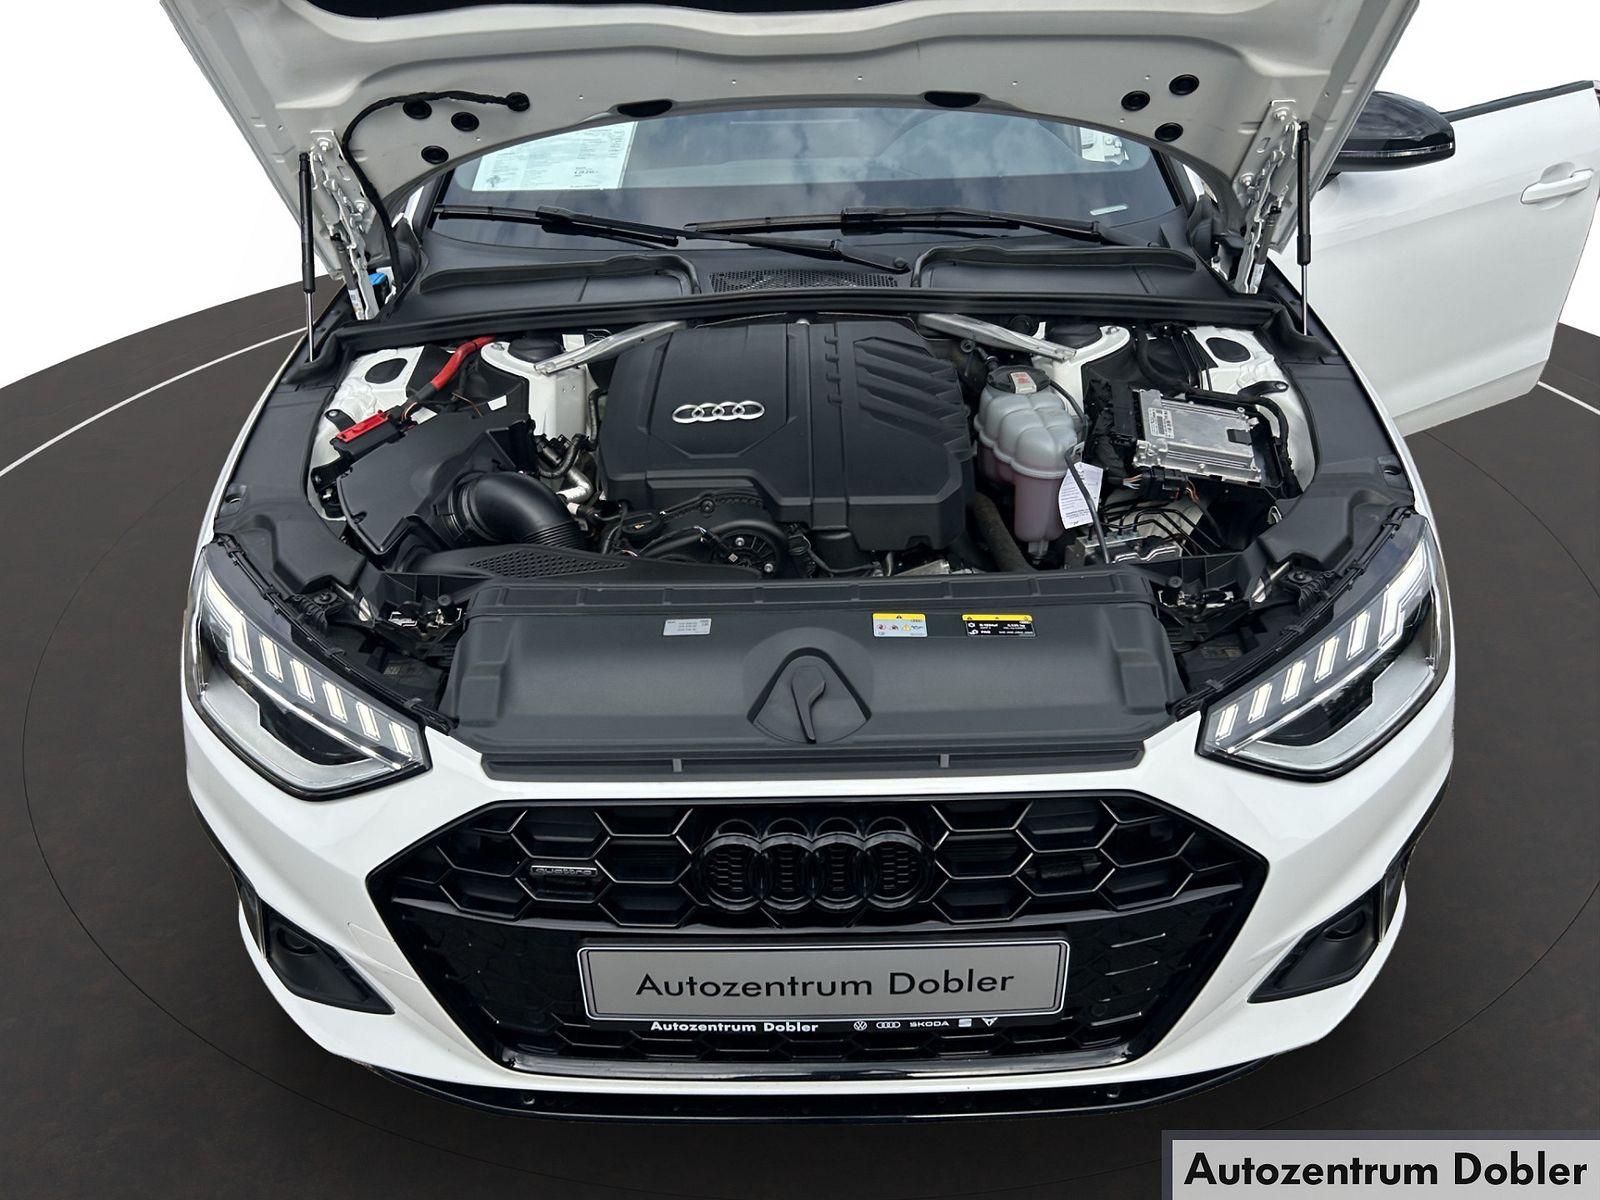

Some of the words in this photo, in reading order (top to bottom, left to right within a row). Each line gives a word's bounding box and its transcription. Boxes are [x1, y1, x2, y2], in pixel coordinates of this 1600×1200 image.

[636, 973, 872, 998] Autozentrum
[889, 968, 1015, 996] Dobler
[650, 1021, 757, 1033] Autozentrum
[763, 1021, 819, 1033] Dobler
